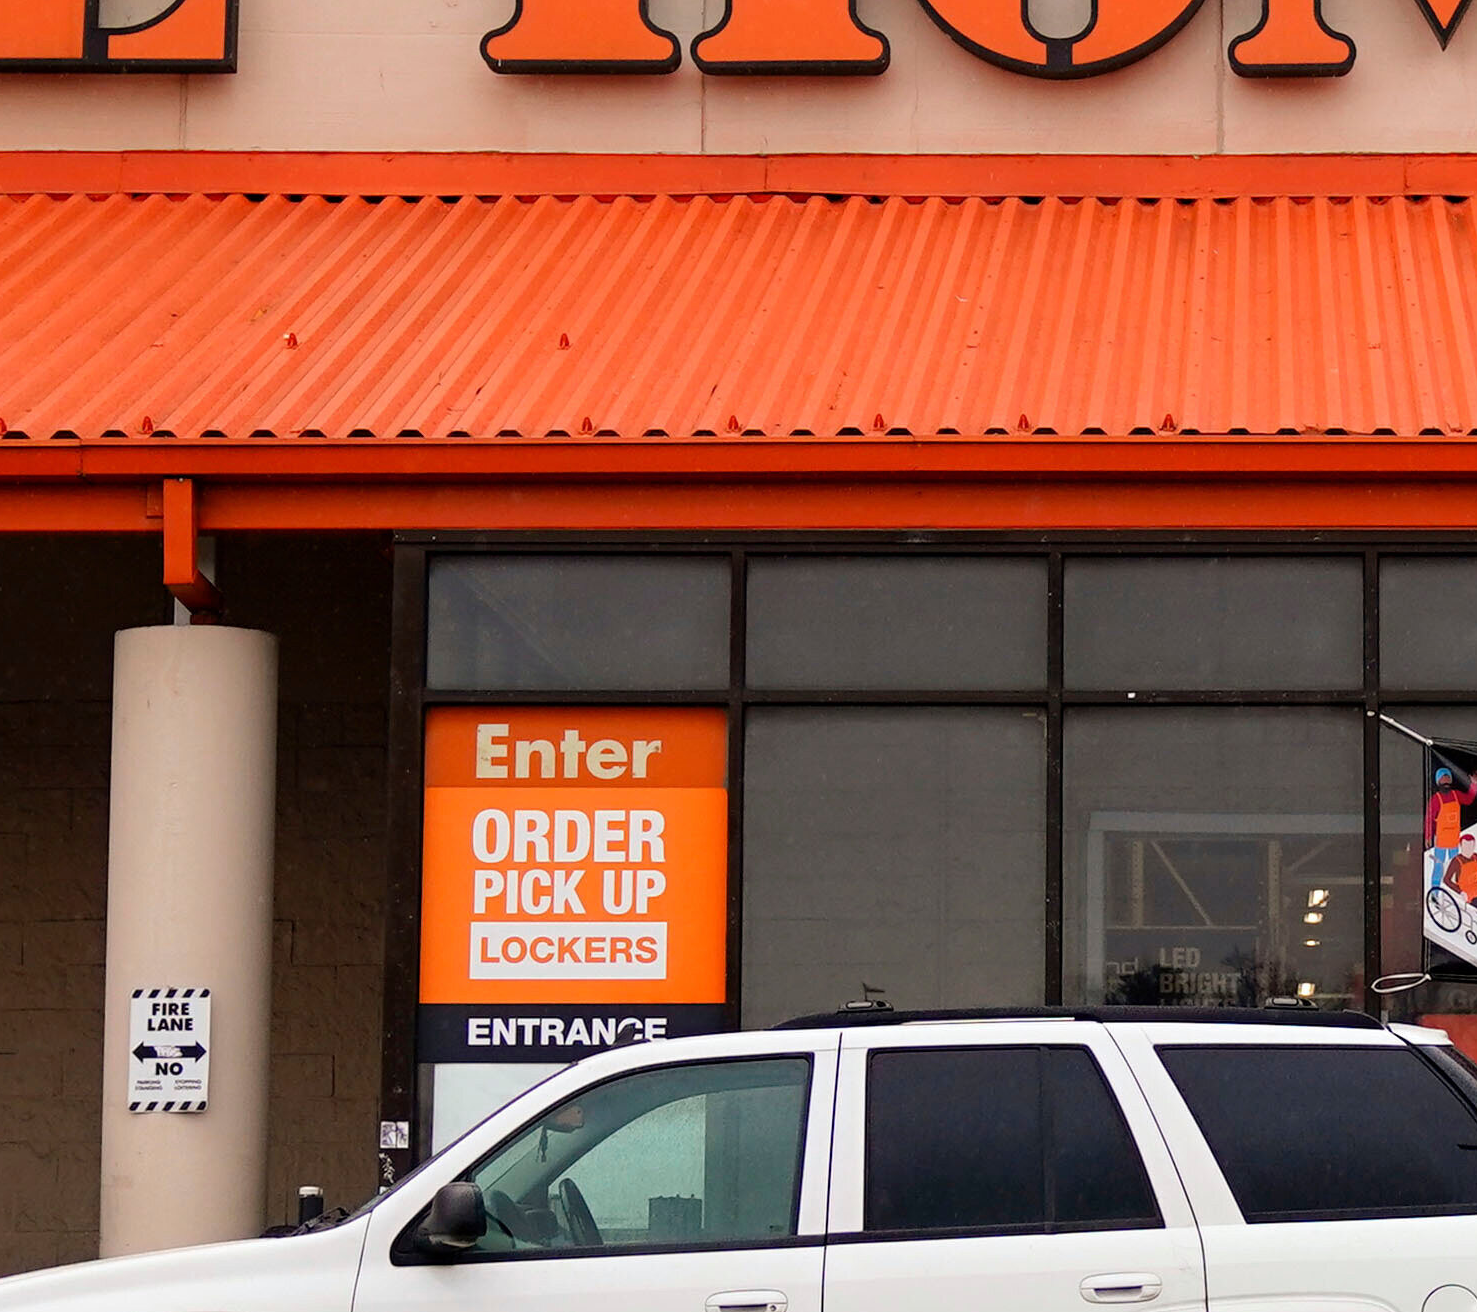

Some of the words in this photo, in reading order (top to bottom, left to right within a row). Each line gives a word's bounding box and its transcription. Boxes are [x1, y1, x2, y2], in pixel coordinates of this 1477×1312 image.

[475, 723, 662, 780] Enter
[472, 808, 666, 864] ORDER
[473, 869, 586, 915] PICK
[602, 869, 667, 915] UP
[480, 936, 658, 964] LOCKERS
[1159, 946, 1201, 968] LED
[1158, 972, 1242, 994] BRIGHT
[152, 1003, 190, 1016] FIRE
[147, 1018, 193, 1031] LANE
[467, 1017, 668, 1047] ENTRANCE
[155, 1062, 183, 1076] NO
